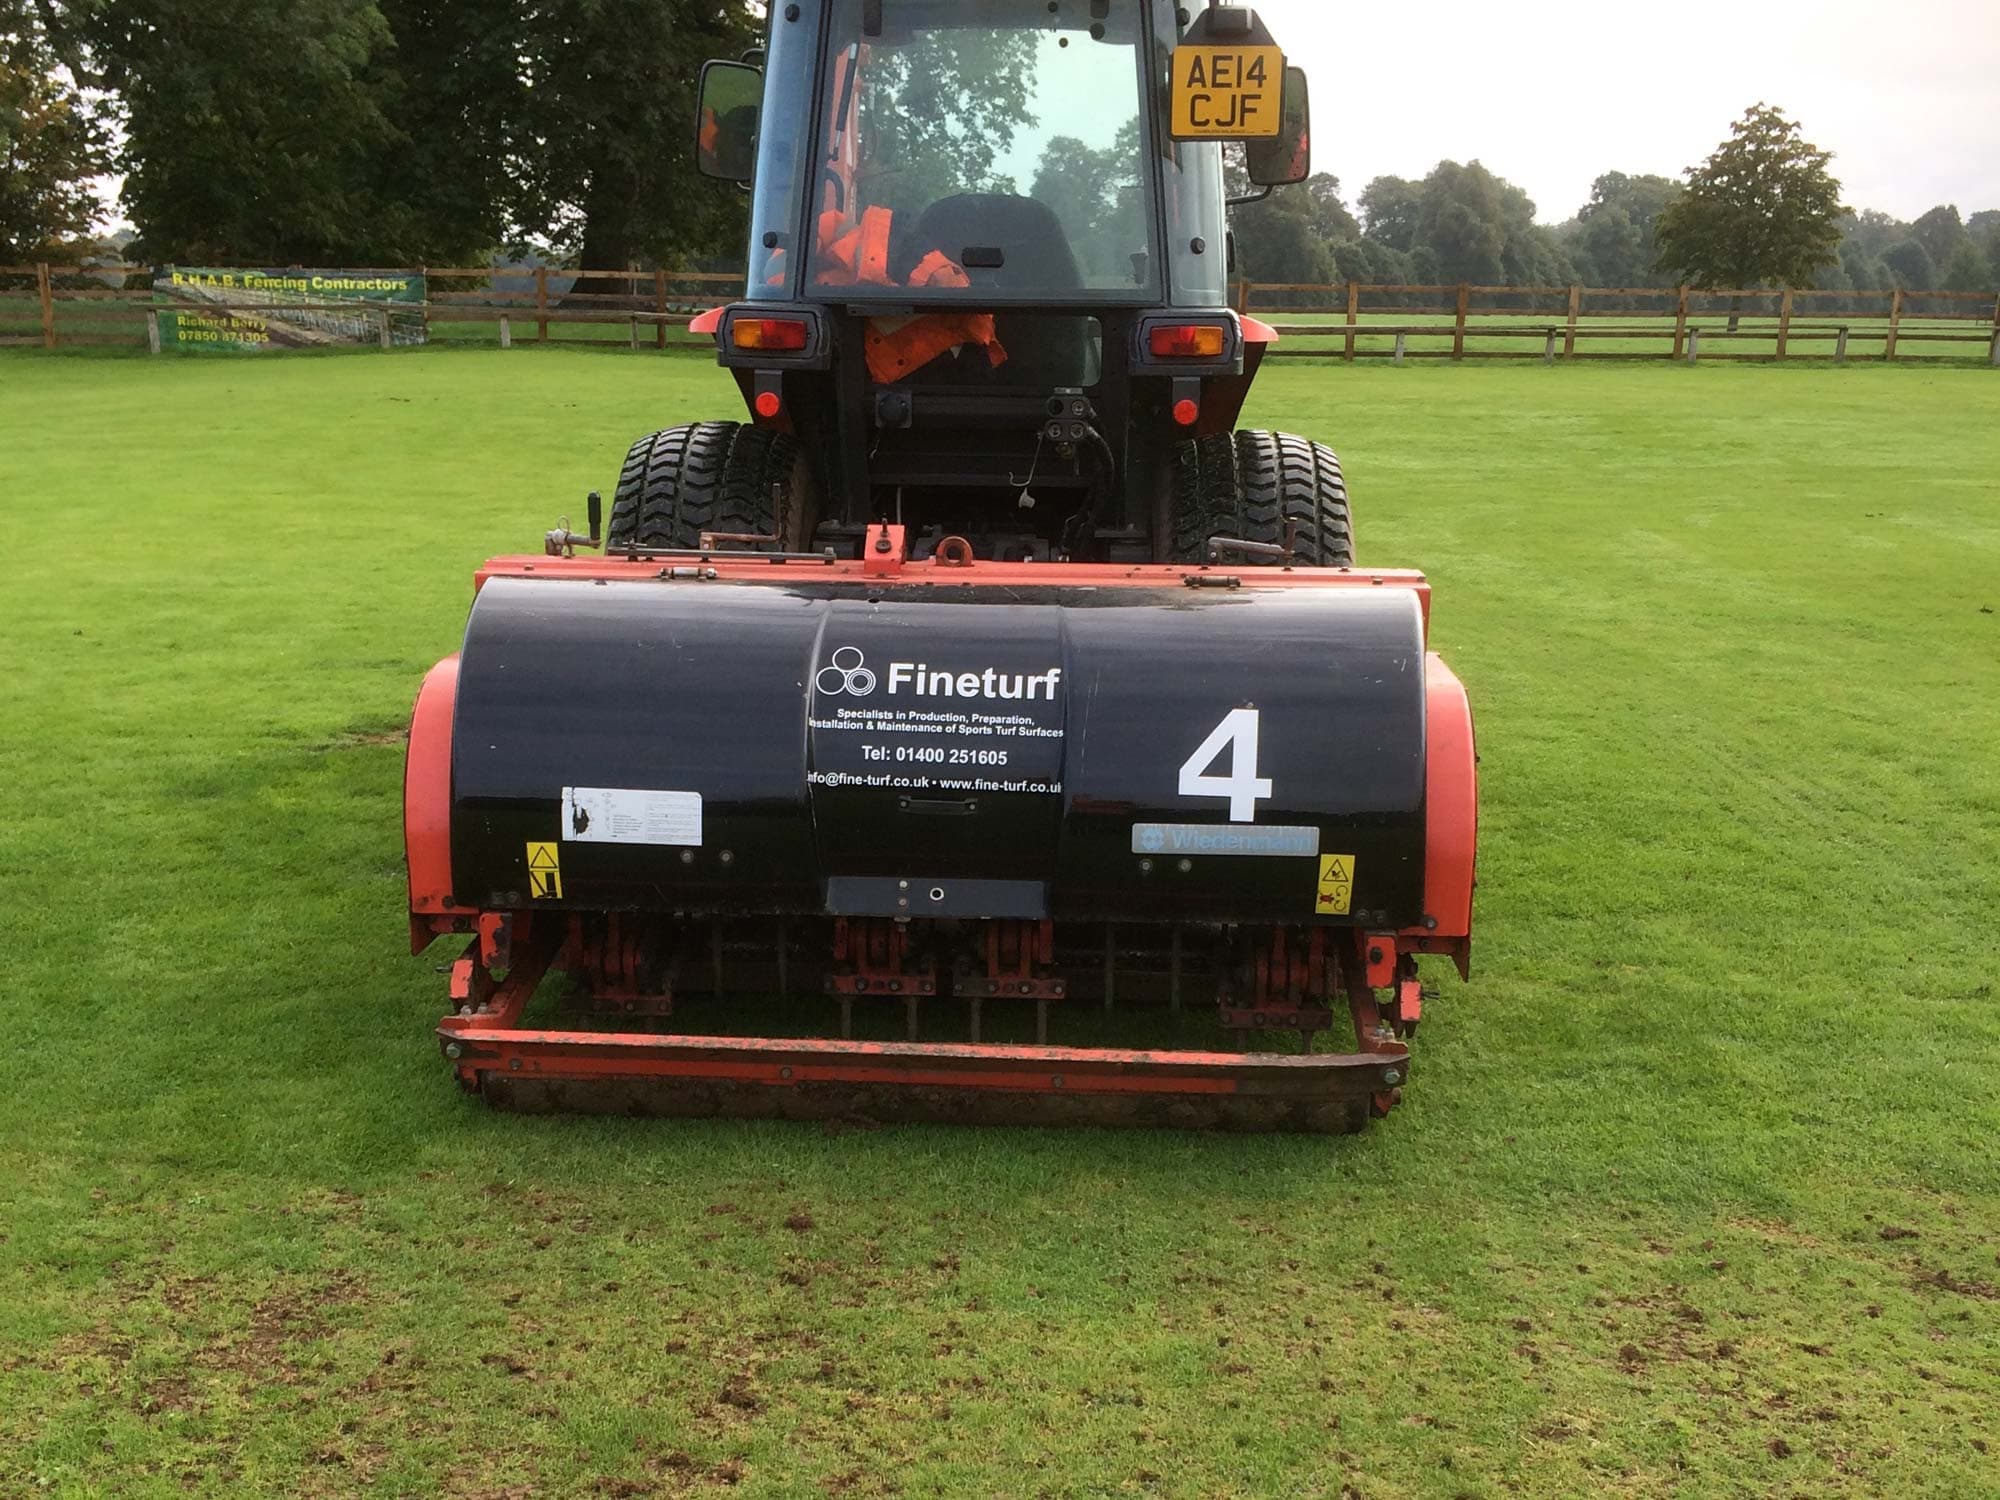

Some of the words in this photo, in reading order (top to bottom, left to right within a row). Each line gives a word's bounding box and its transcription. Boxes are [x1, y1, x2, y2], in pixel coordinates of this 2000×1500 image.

[1186, 55, 1267, 88] AE14
[1190, 94, 1262, 127] CJF
[243, 275, 307, 291] Fencing
[312, 276, 408, 291] Contractors
[177, 316, 227, 328] Richard
[178, 330, 218, 342] 07850
[888, 662, 1062, 701] Fineturf
[837, 708, 894, 720] Specialists
[896, 710, 906, 720] in
[908, 711, 969, 724] Production,
[971, 713, 1035, 726] Preparation,
[866, 720, 874, 731] &
[877, 721, 943, 733] Maintenance
[945, 724, 956, 734] of
[958, 724, 993, 736] Sports
[995, 726, 1016, 736] Turf
[1018, 726, 1064, 738] Surfaces
[861, 745, 891, 761] Tel:
[896, 746, 945, 763] 01400
[949, 748, 1008, 765] 251605
[1178, 708, 1273, 823] 4
[1171, 829, 1313, 850] Wiedenmann
